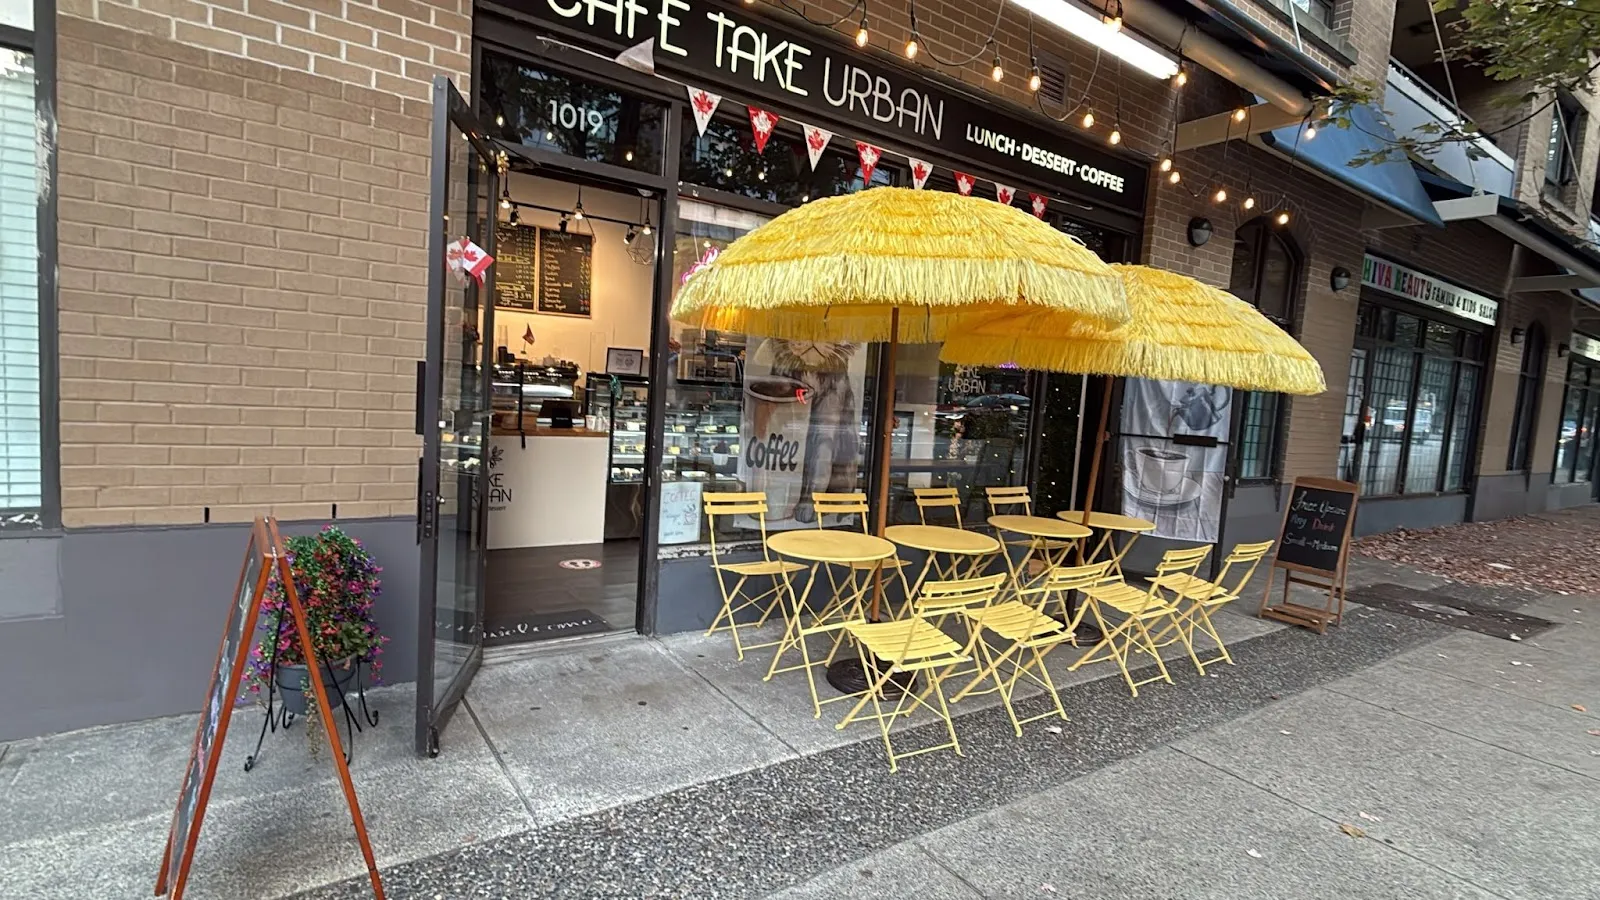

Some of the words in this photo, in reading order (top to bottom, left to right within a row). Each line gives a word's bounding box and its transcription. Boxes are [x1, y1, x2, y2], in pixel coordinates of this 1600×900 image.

[706, 11, 811, 97] TAKE
[823, 56, 944, 141] URBAN
[549, 99, 604, 135] 1019
[1363, 257, 1393, 289] HIVA
[1394, 268, 1432, 301] BEAUTY
[948, 378, 987, 394] URBAN
